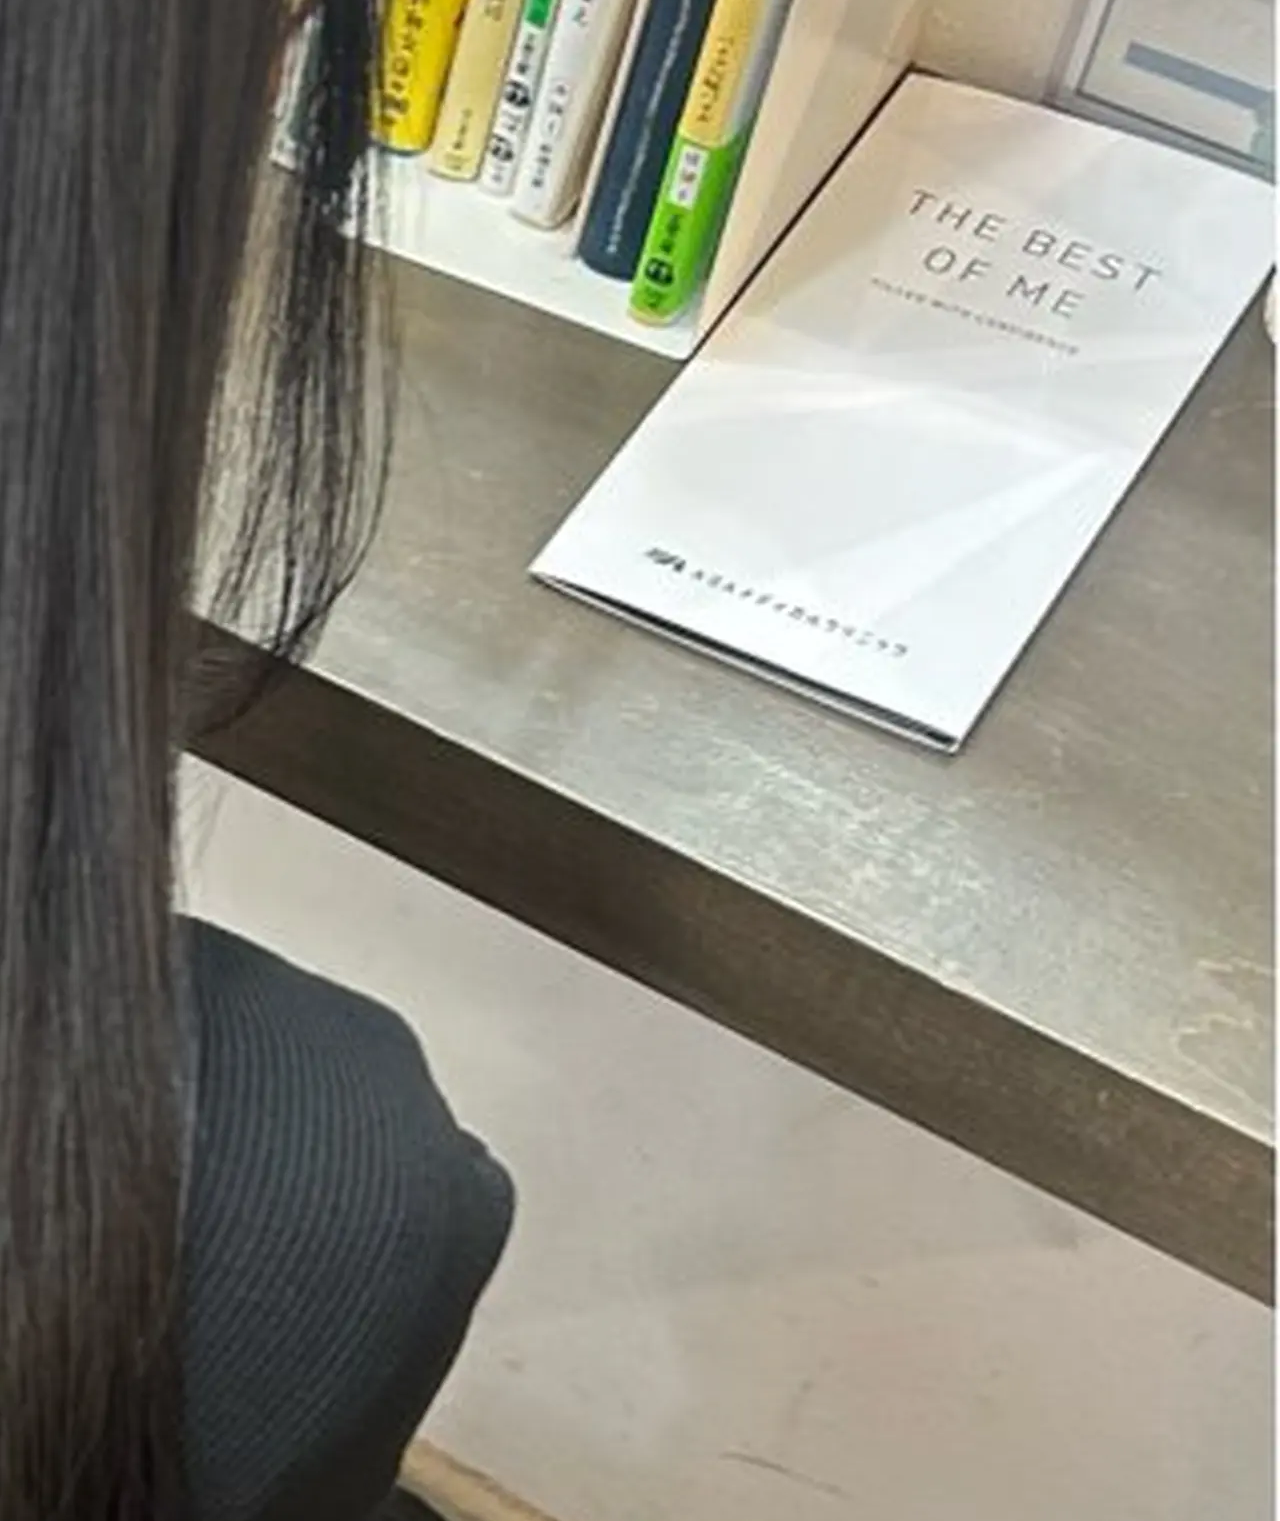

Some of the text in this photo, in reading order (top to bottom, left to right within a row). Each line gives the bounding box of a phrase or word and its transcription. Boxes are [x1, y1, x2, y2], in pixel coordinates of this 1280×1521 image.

[909, 188, 1163, 291] THE BEST
[922, 245, 1087, 320] OF ME
